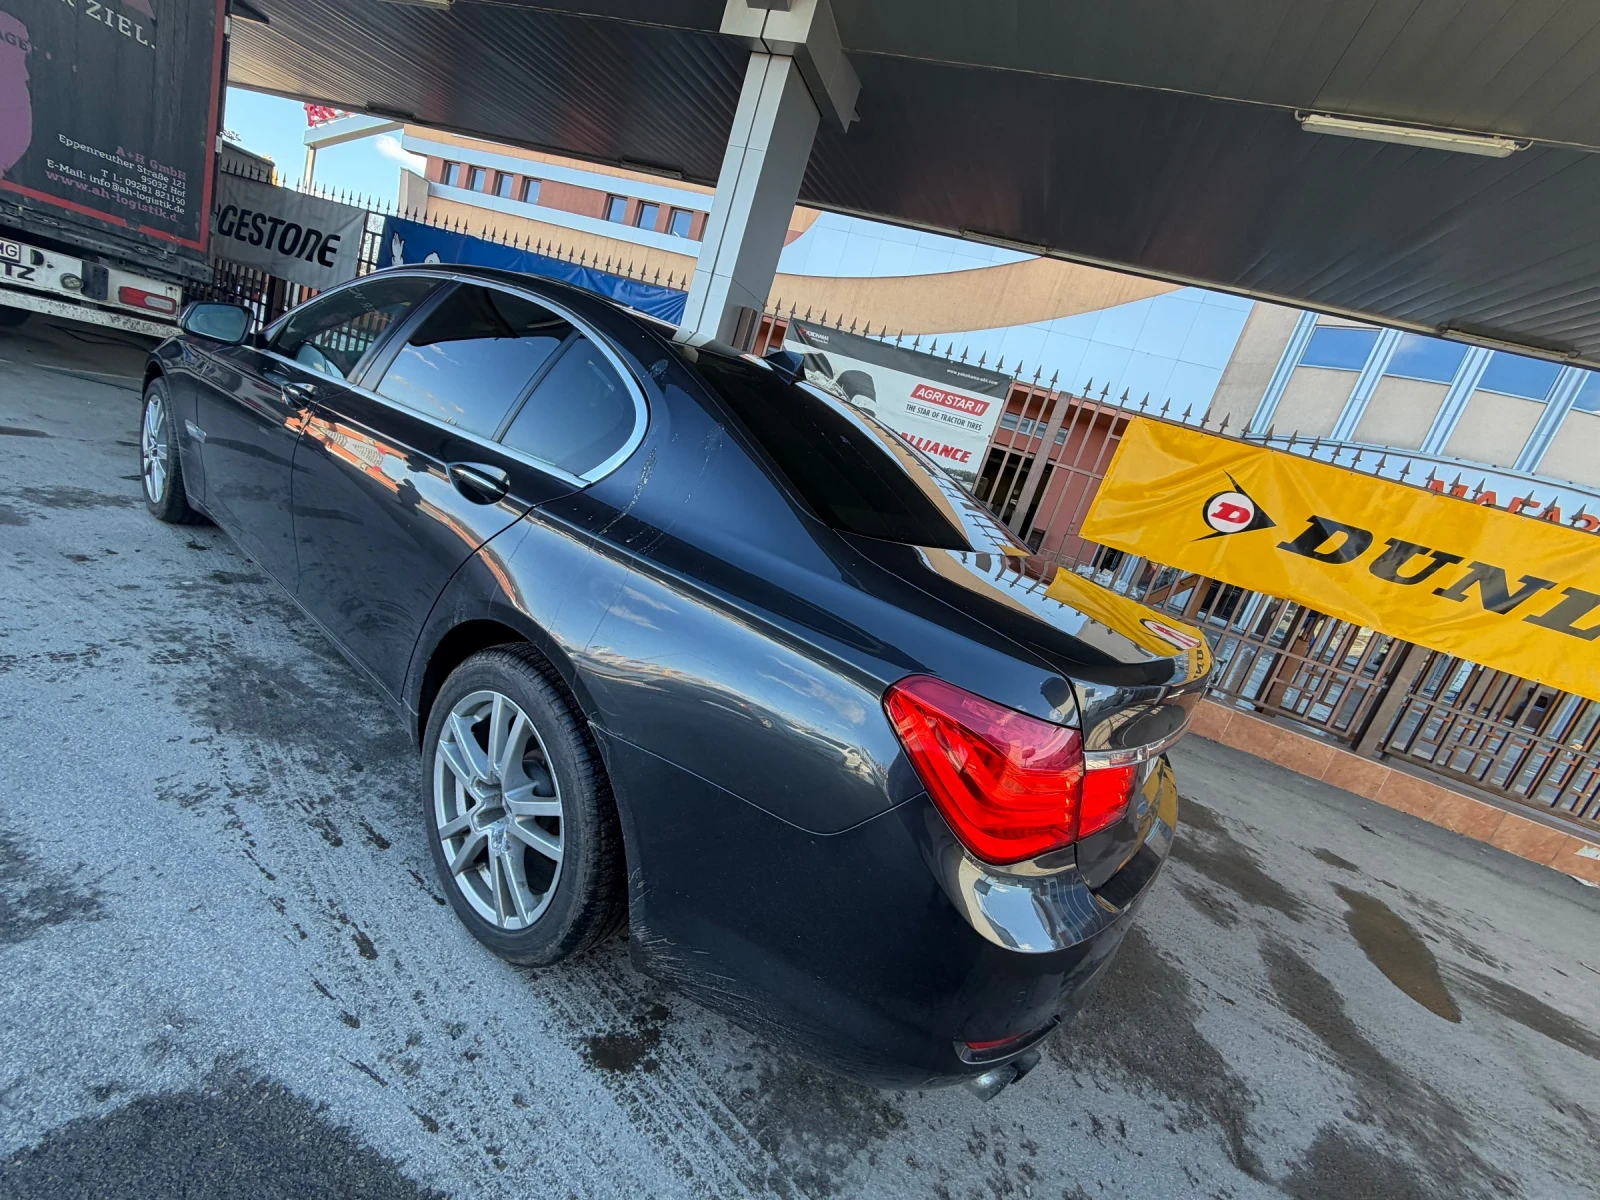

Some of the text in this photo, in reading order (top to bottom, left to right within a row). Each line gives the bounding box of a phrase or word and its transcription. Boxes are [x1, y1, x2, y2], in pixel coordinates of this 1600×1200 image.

[85, 0, 156, 50] ZIEL.
[46, 159, 86, 180] E-Mail:
[58, 134, 186, 190] Eppenreuther Straße 121
[115, 146, 186, 181] A+H GmbH
[45, 170, 178, 223] www.ah-logistik.d
[125, 179, 152, 194] 09281
[155, 189, 186, 206] 821150
[141, 175, 186, 198] 95032 Hof
[216, 203, 341, 268] GESTONE
[916, 387, 984, 414] AGRI STAR II
[906, 403, 982, 431] THE STAR OF TRACTOR TIRES
[901, 432, 972, 463] ALLIANCE
